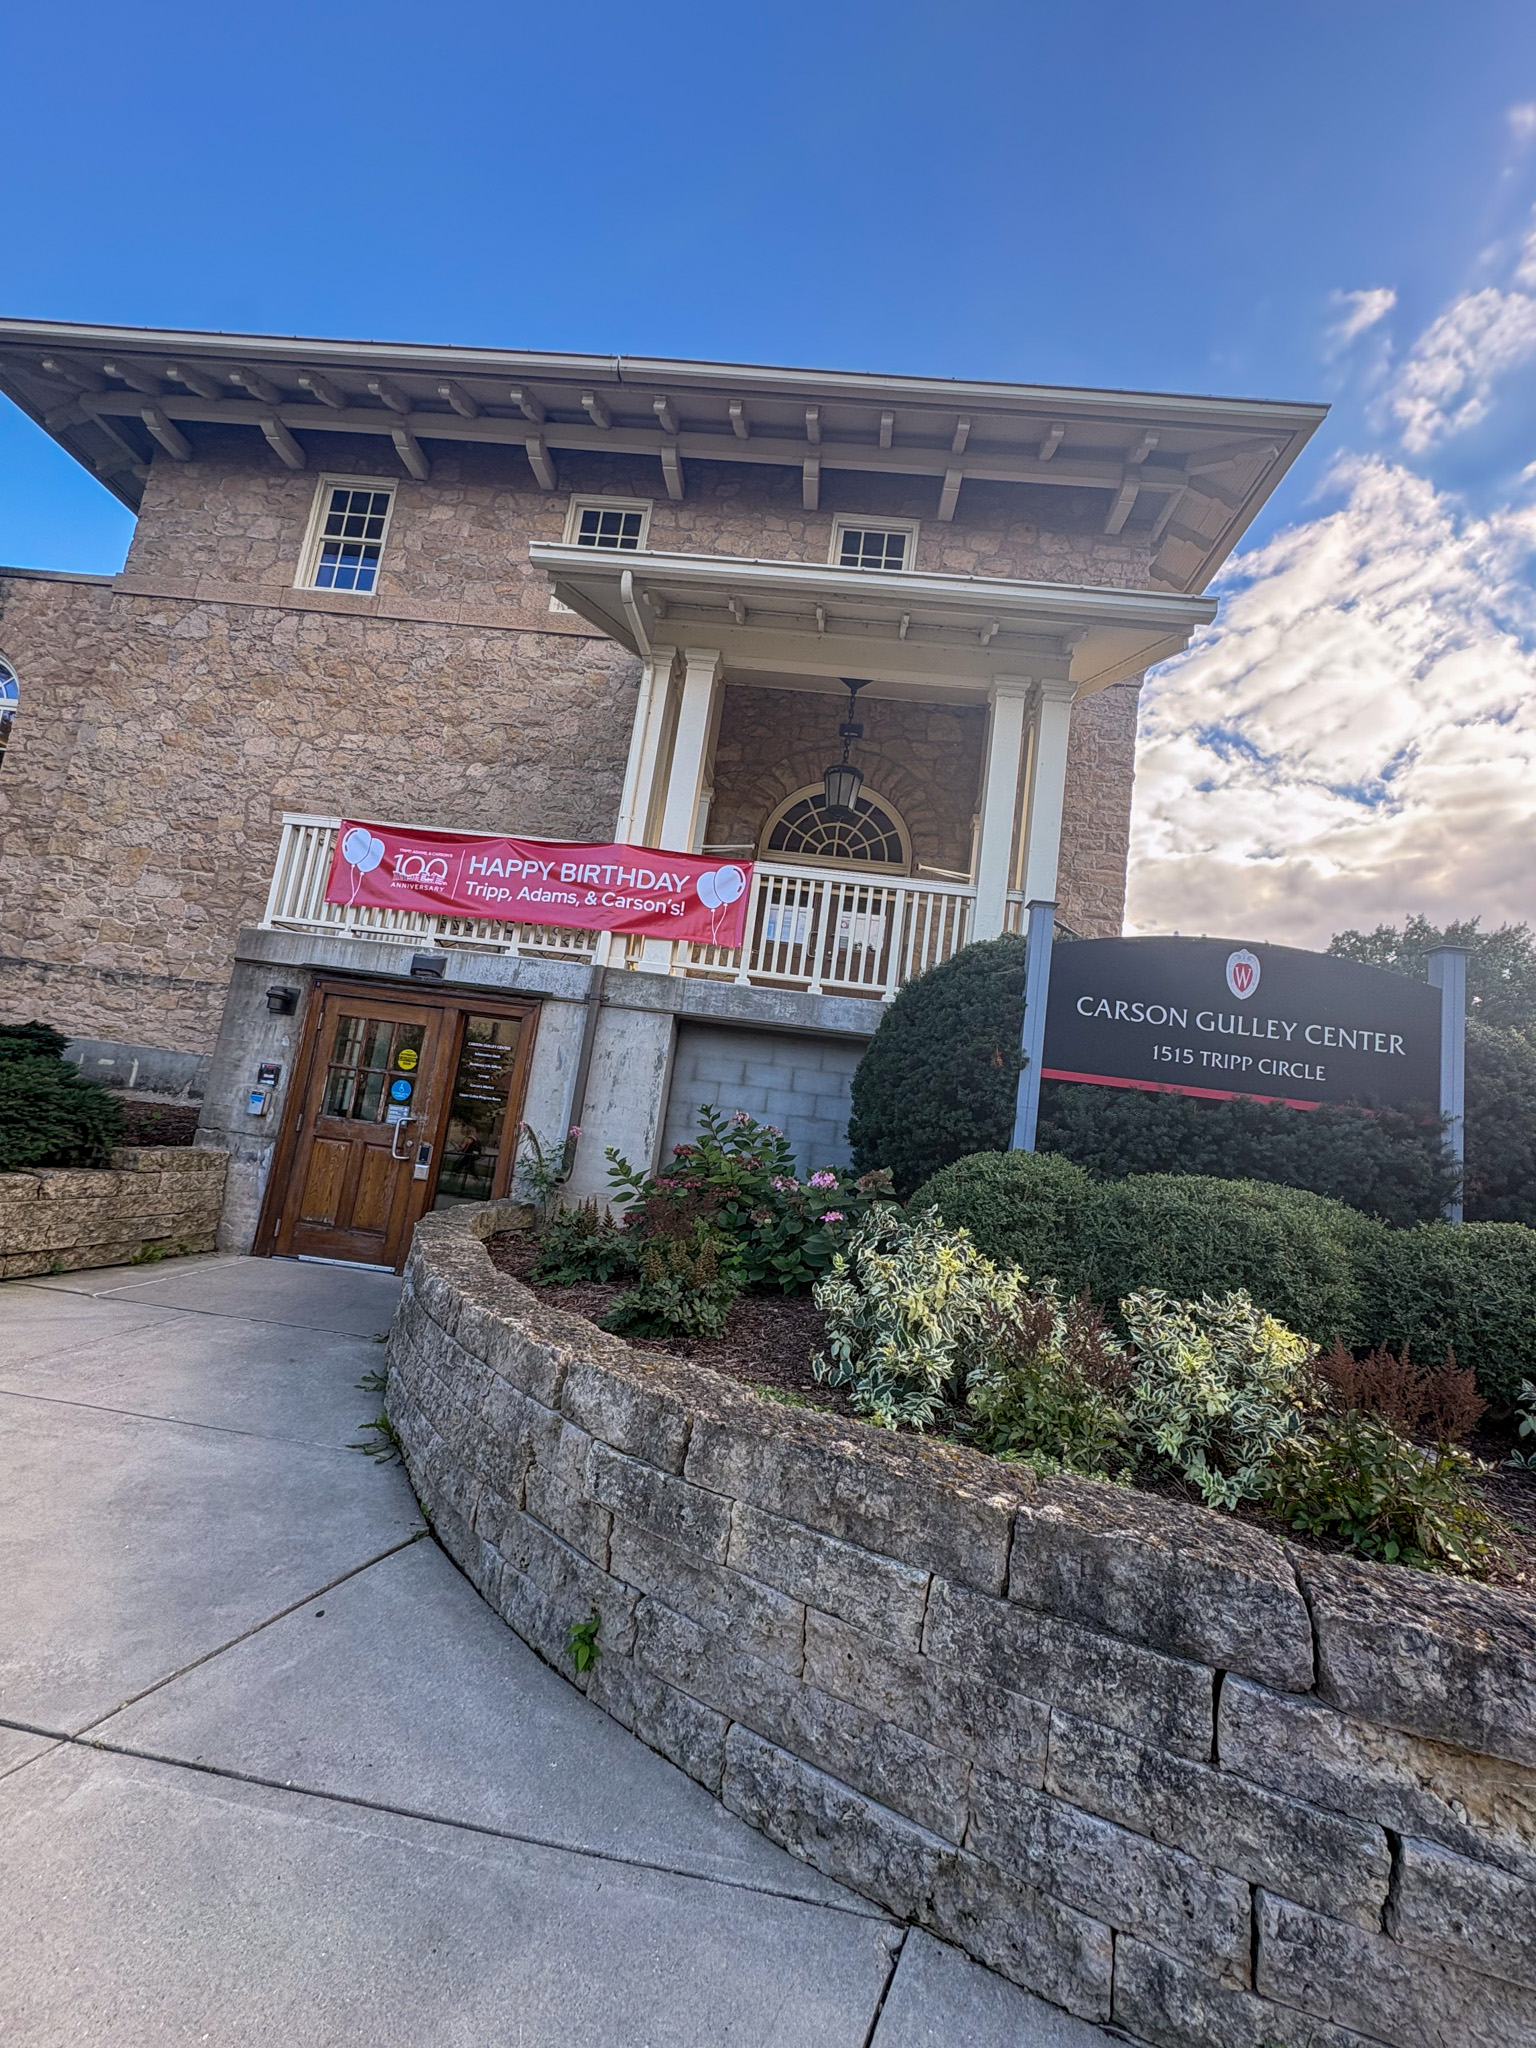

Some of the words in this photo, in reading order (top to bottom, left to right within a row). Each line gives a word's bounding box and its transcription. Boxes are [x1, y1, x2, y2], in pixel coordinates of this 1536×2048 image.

[394, 854, 448, 878] 100
[468, 855, 556, 881] HAPPY
[560, 862, 691, 893] BIRTHDAY
[390, 881, 445, 892] ANNIVERSARY
[465, 881, 513, 902] Tripp,
[516, 886, 580, 907] Adams,
[584, 890, 598, 906] &
[601, 892, 685, 917] Carson's!
[1234, 966, 1252, 989] W
[1076, 996, 1188, 1029] CARSON
[1195, 1011, 1298, 1041] GULLEY
[1304, 1024, 1406, 1056] CENTER
[1153, 1044, 1194, 1064] 1515
[1199, 1050, 1253, 1072] TRIPP
[1258, 1058, 1327, 1081] CIRCLE
